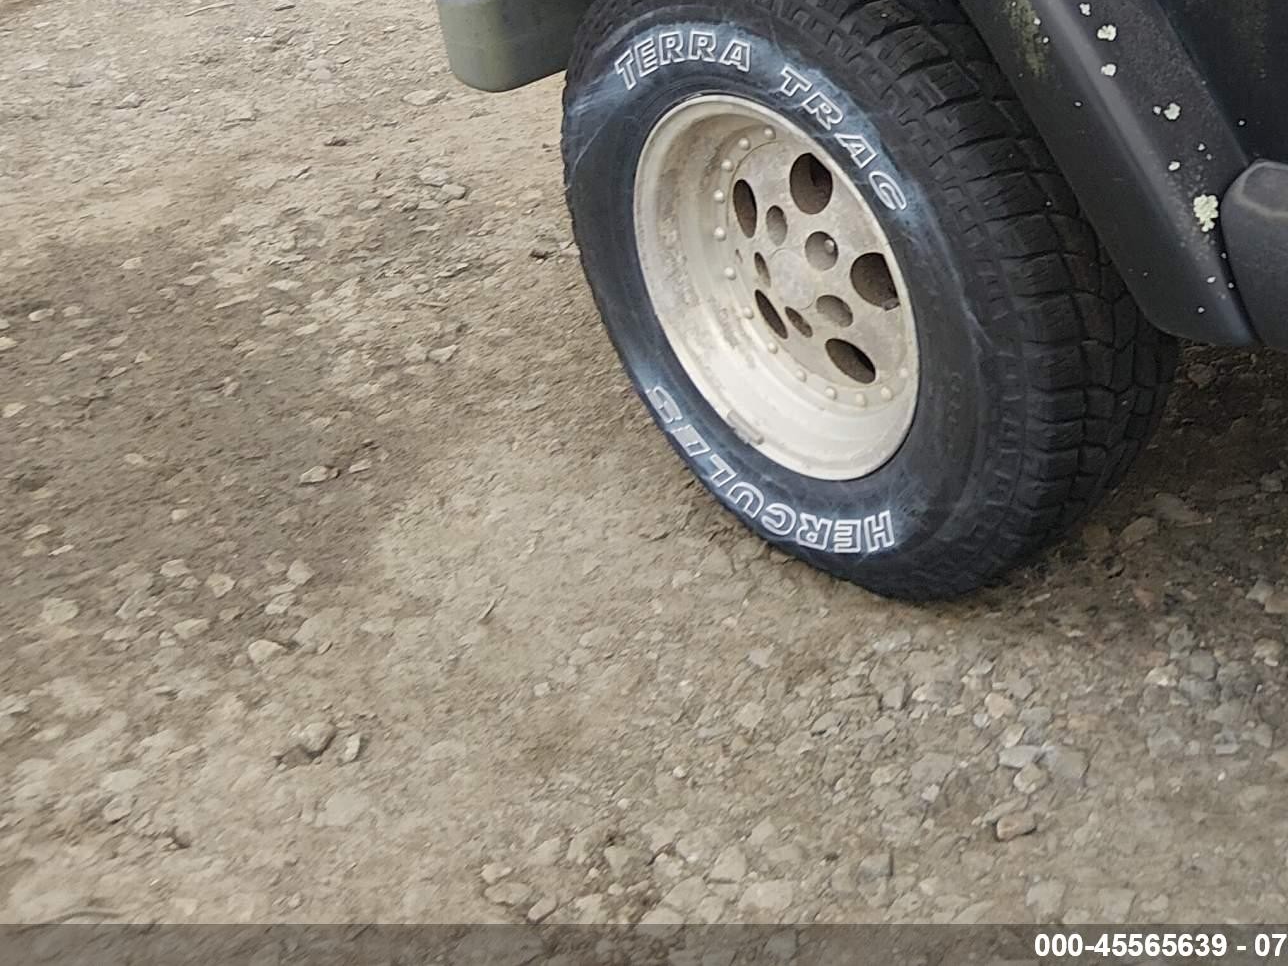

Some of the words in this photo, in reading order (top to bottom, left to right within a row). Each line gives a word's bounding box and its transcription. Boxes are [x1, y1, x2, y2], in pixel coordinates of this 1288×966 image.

[614, 30, 751, 90] TERRA
[780, 66, 907, 211] TRAC
[645, 385, 896, 554] HERCULES
